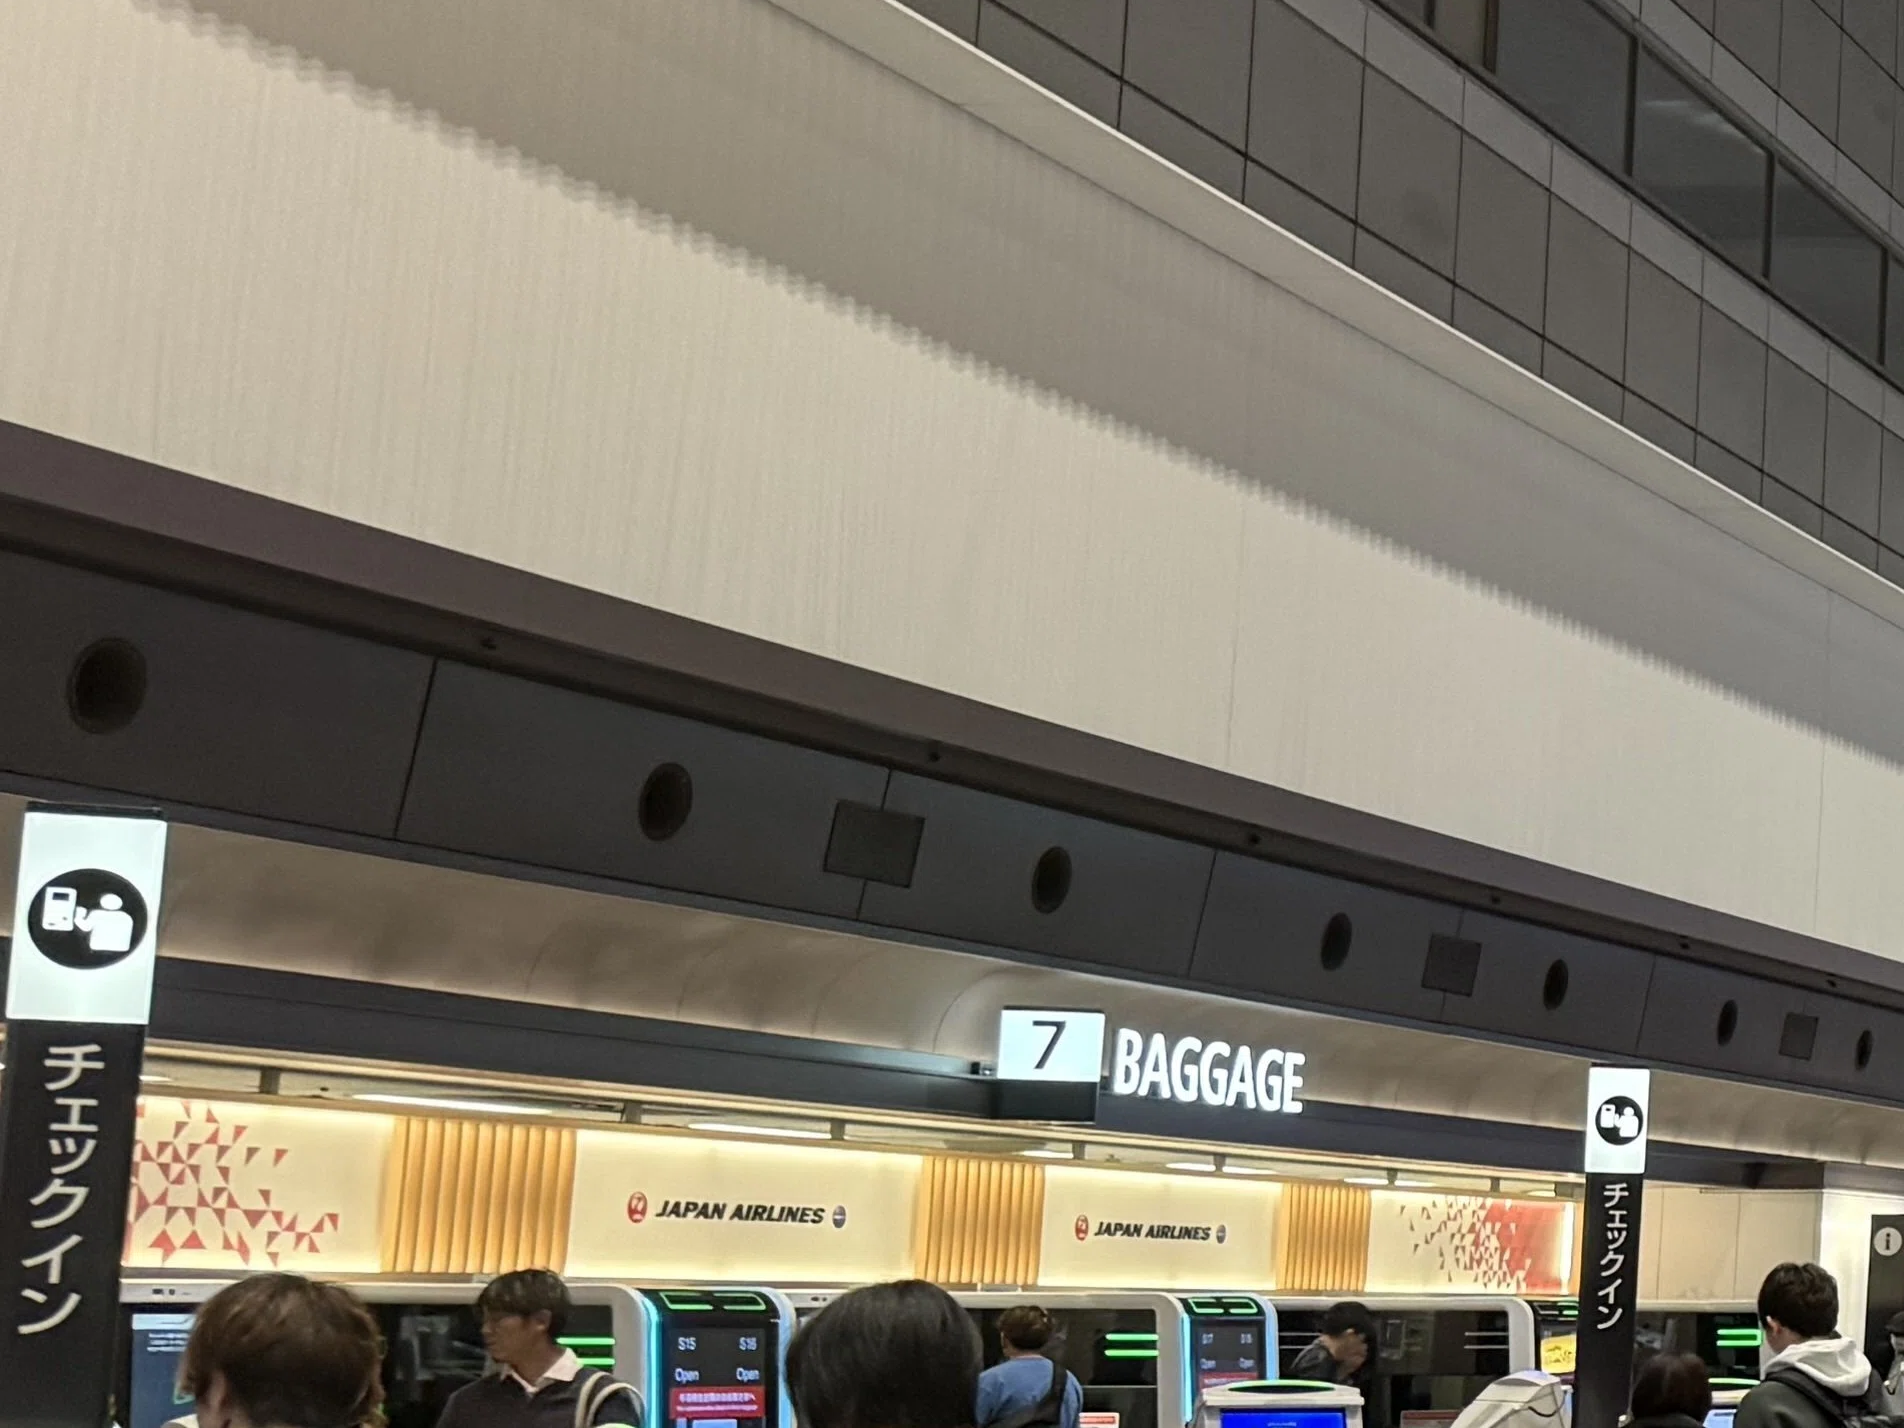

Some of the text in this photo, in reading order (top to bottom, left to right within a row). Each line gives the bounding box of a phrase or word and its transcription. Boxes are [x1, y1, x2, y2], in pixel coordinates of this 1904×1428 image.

[1032, 1020, 1307, 1114] 7 BAGGAGE
[18, 1043, 105, 1335] チェックイン
[655, 1200, 826, 1225] JAPAN AIRLINES
[1094, 1221, 1212, 1241] JAPAN AIRLINES
[1597, 1182, 1629, 1330] チェックイン
[677, 1336, 697, 1351] S15
[675, 1367, 760, 1383] Open Open
